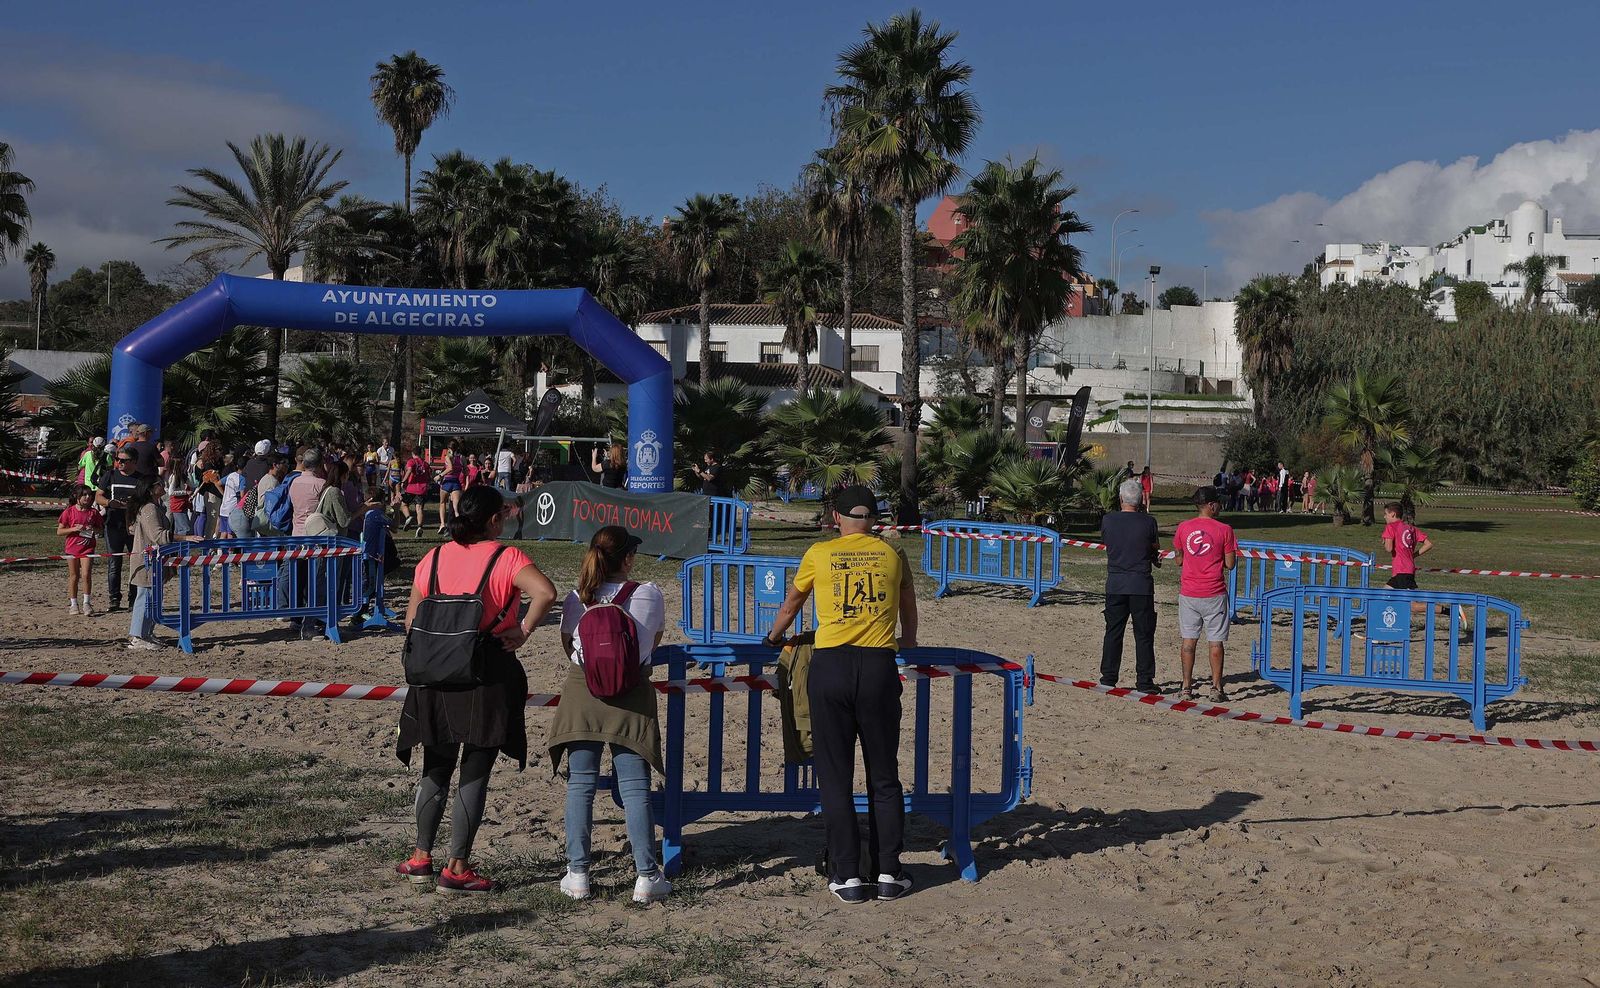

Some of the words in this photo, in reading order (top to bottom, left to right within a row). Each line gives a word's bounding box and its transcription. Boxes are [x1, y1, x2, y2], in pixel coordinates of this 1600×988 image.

[322, 289, 497, 308] AYUNTAMIENTO
[335, 311, 358, 324] DE
[365, 311, 485, 327] ALGECIRAS
[573, 499, 620, 527] TOYOTA
[624, 506, 673, 533] TOMAX
